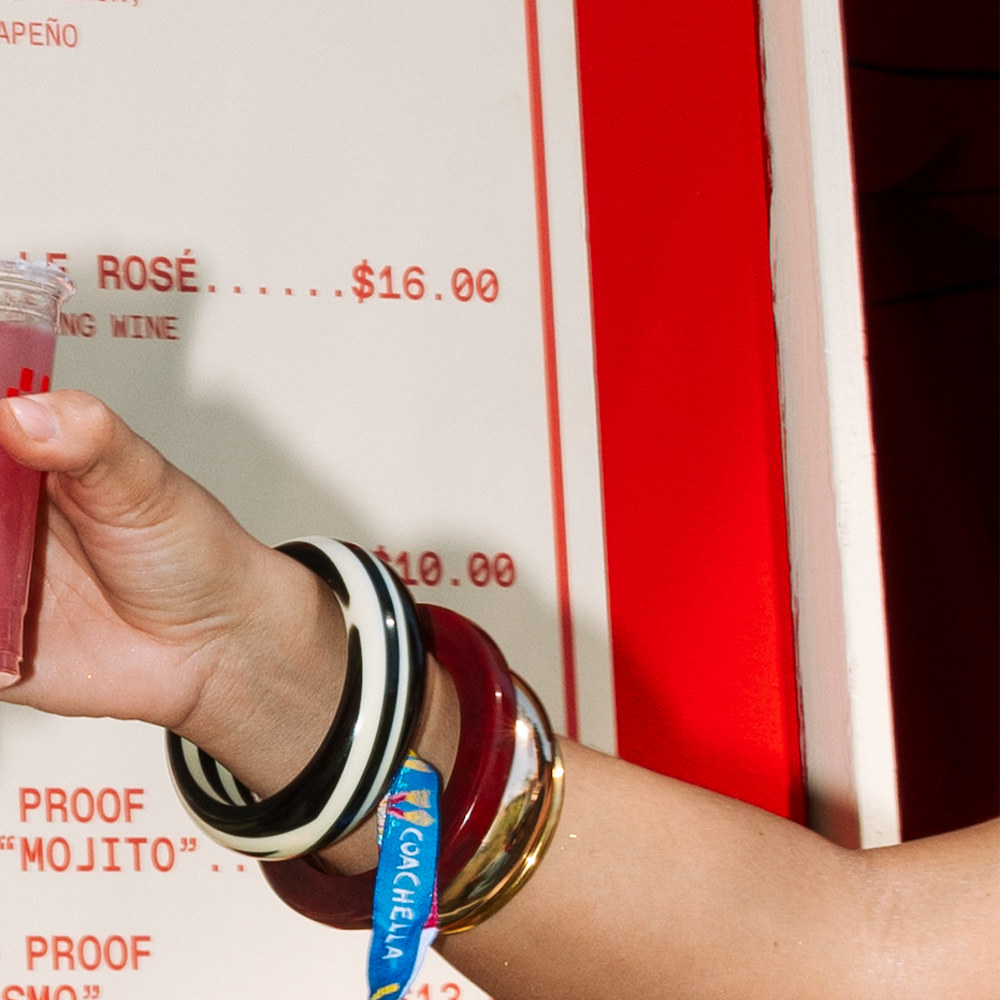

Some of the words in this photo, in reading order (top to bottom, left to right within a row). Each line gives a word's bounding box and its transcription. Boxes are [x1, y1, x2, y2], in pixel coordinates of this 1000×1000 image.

[351, 259, 499, 303] $16.00
[110, 314, 181, 341] WINE
[18, 786, 145, 824] PROOF
[382, 827, 424, 960] COACHELLA
[25, 934, 153, 972] PROOF
